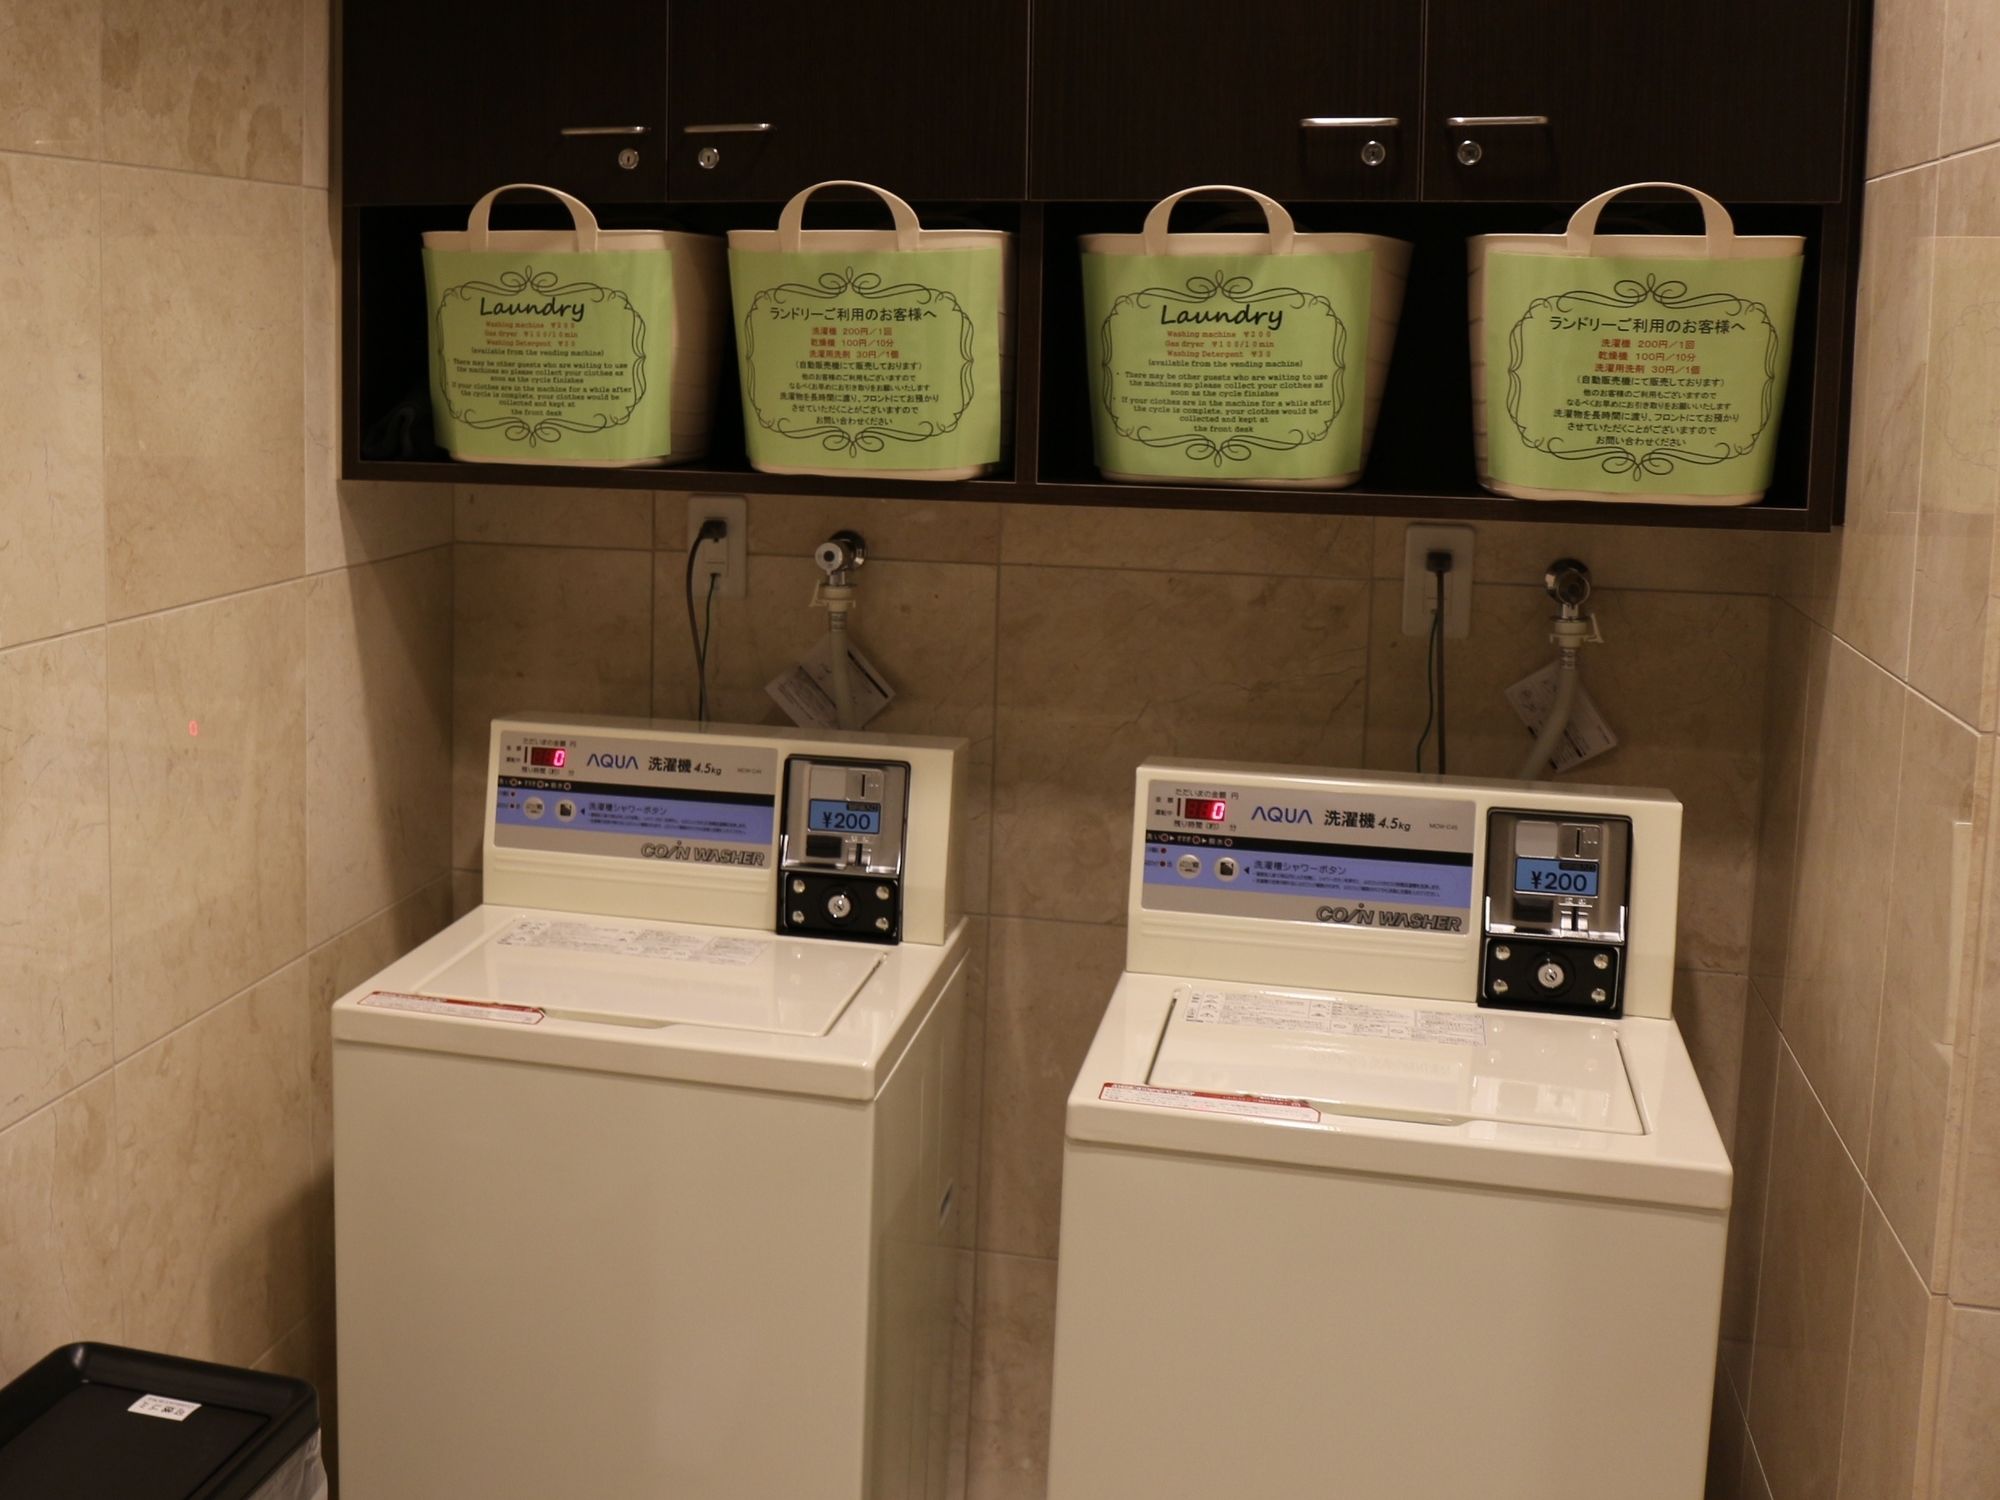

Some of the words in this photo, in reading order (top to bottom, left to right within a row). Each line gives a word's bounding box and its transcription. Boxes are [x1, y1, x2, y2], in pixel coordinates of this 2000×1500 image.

[480, 297, 585, 322] Laundry
[770, 307, 936, 321] ランドリーご利用のお客様へ
[1161, 304, 1283, 330] Laundry
[1550, 316, 1745, 334] ランドリーご利用のお客様へ
[1125, 371, 1147, 379] There
[1149, 373, 1165, 382] may
[1203, 374, 1231, 382] guests
[1144, 380, 1182, 388] machines
[1195, 382, 1222, 390] please
[1224, 382, 1256, 390] collect
[1258, 383, 1278, 391] your
[1149, 406, 1171, 414] cycle
[1226, 409, 1245, 417] your
[1247, 408, 1280, 416] clothes
[1180, 415, 1220, 423] collected
[553, 750, 565, 766] 0
[586, 753, 638, 769] AQUA
[648, 756, 691, 773] 洗濯機
[694, 762, 722, 776] 4.5kg
[1212, 802, 1225, 820] 0
[1251, 806, 1313, 824] AQUA
[822, 811, 871, 830] ¥200
[1324, 810, 1376, 828] 洗濯機
[1378, 818, 1411, 831] 4.5kg
[641, 840, 691, 860] COIN
[694, 847, 765, 866] WASHER
[1531, 870, 1587, 891] ¥200
[1316, 903, 1375, 925] COIN
[1379, 911, 1462, 932] WASHER
